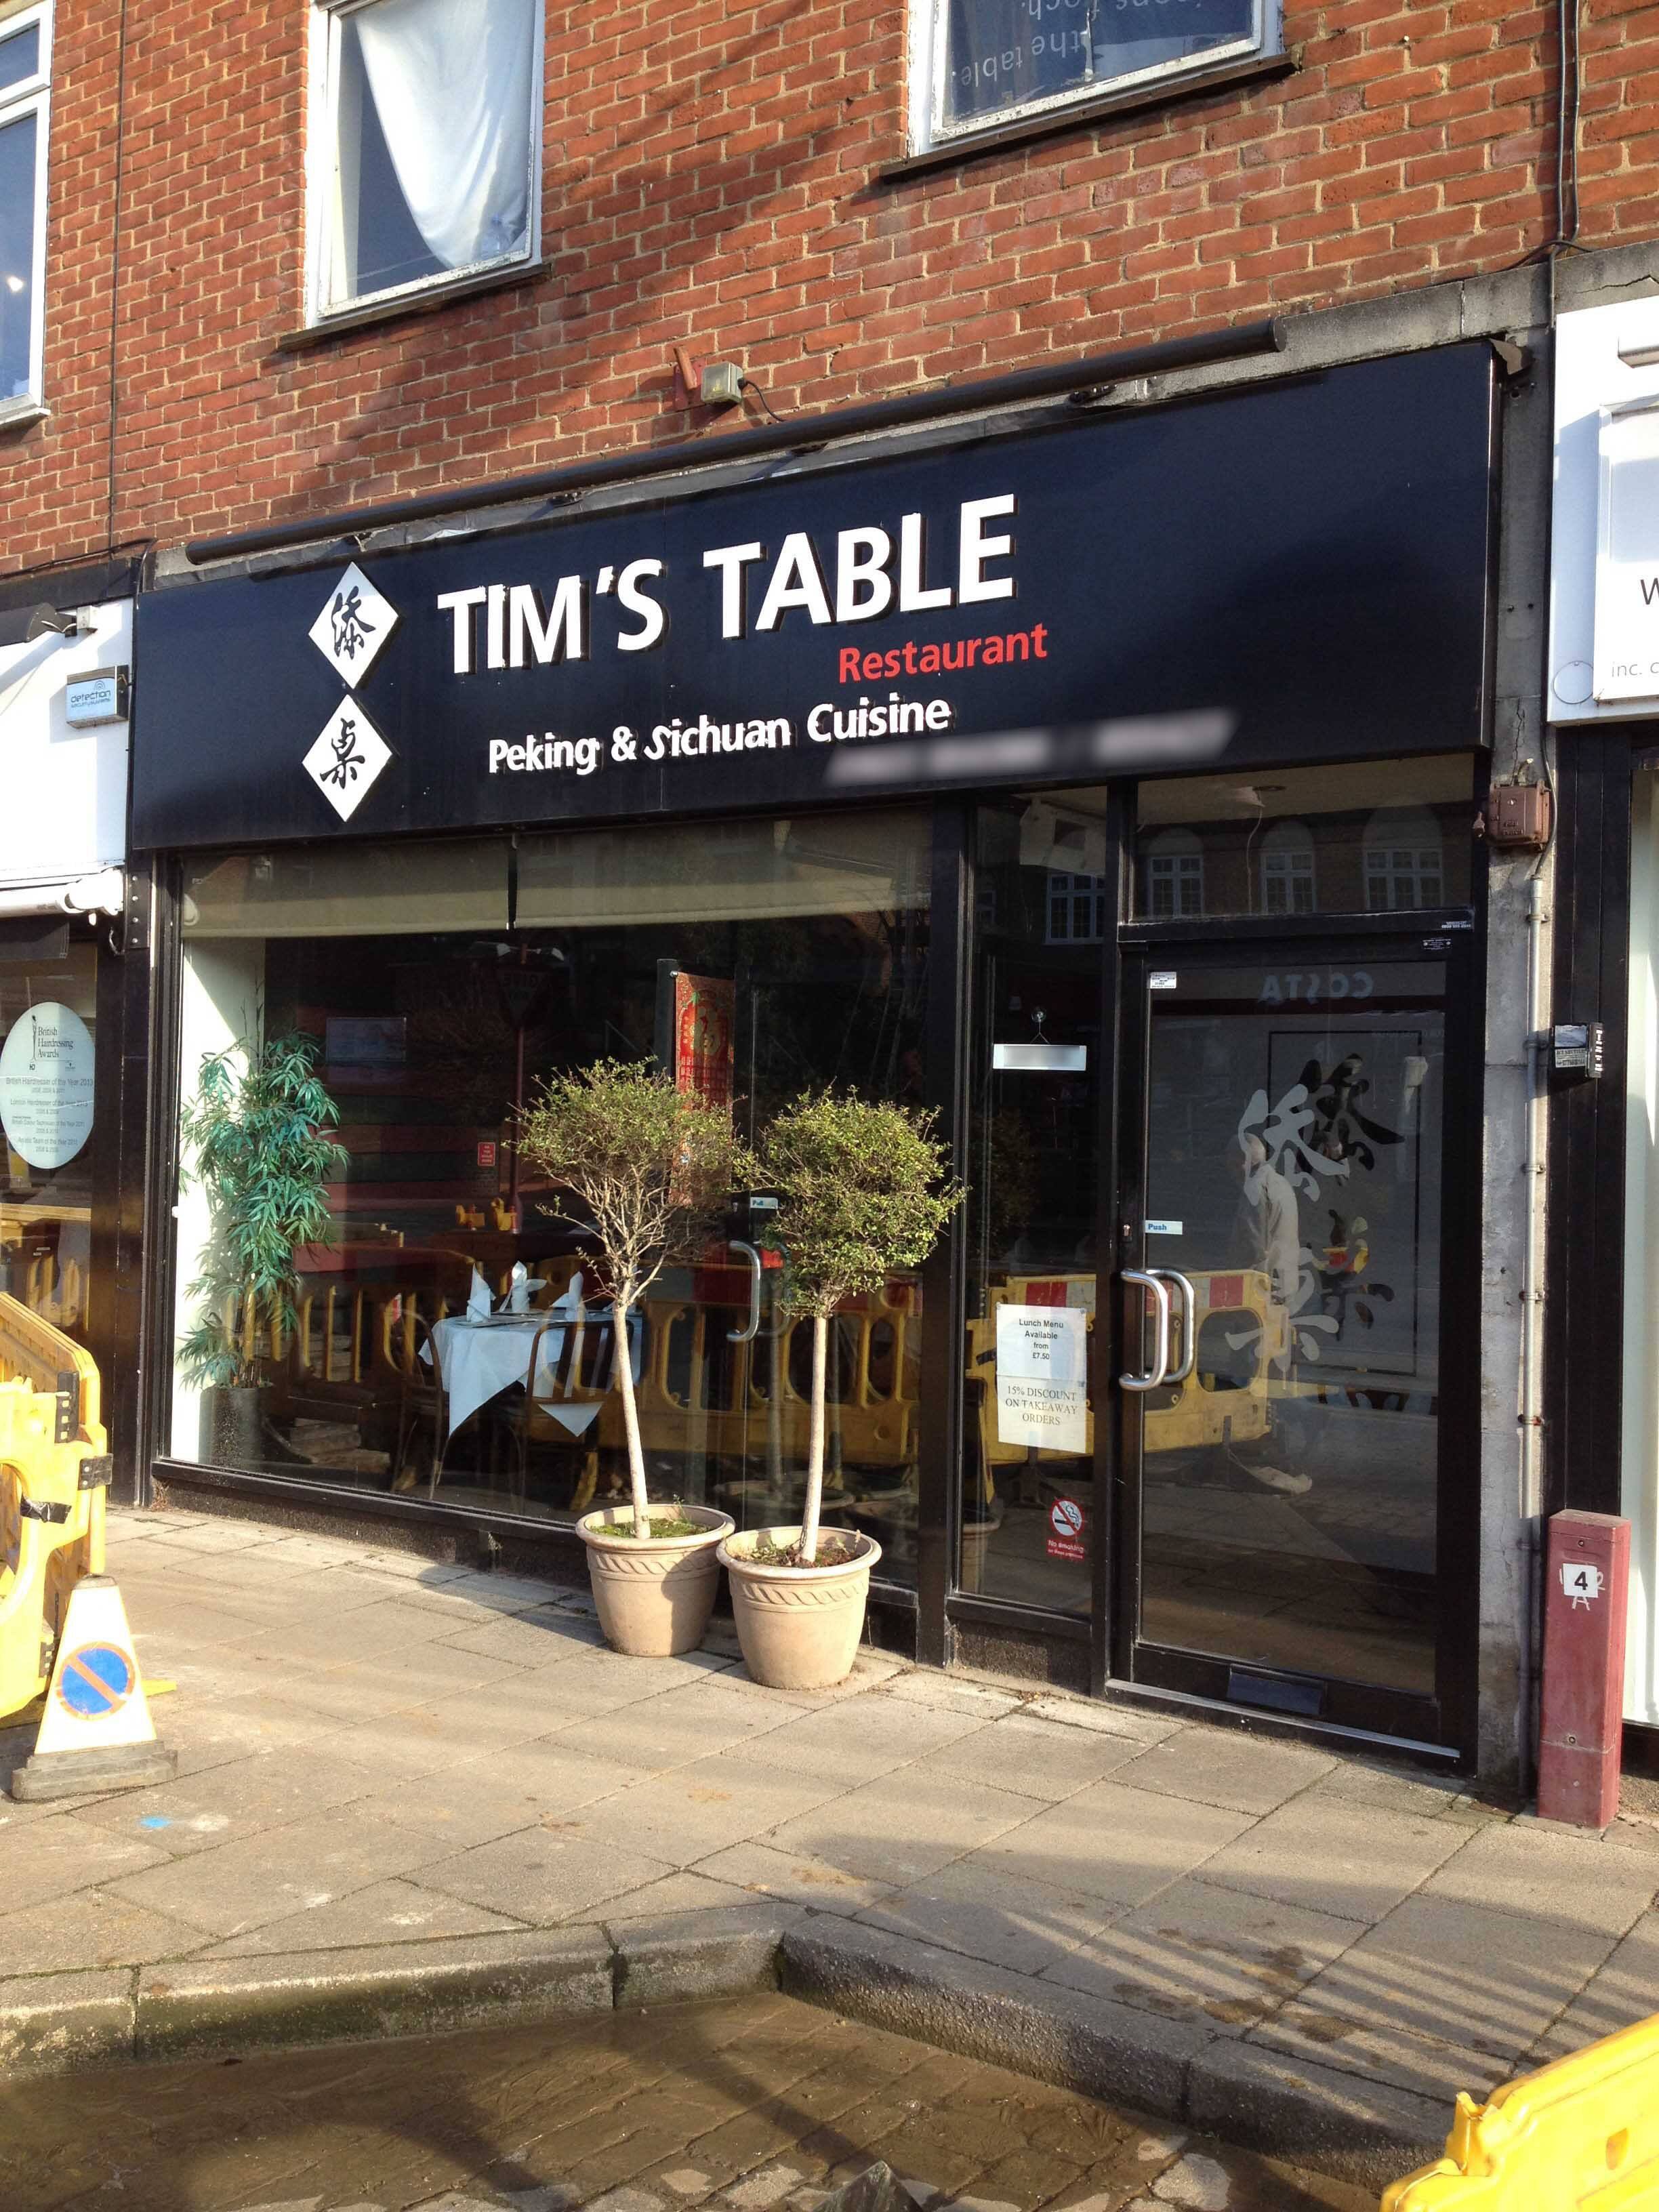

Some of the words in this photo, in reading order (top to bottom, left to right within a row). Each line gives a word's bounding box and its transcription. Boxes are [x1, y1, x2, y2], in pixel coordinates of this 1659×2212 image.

[437, 558, 665, 674] TIM'S
[703, 493, 1016, 639] TABLE
[839, 623, 1048, 683] Restaurant
[1612, 661, 1643, 678] inc.
[488, 731, 601, 775] Peking
[611, 726, 637, 761] &
[644, 714, 791, 760] Sichuan
[806, 691, 951, 742] Cuisine
[1019, 1318, 1042, 1327] Lunch
[1044, 1319, 1064, 1328] Menu
[1025, 1330, 1058, 1340] Available
[1032, 1352, 1050, 1360] £7.50
[1007, 1385, 1025, 1395] 15%
[1027, 1387, 1078, 1401] DISCOUNT
[1005, 1397, 1019, 1407] ON
[1021, 1399, 1078, 1414] TAKEAWAY
[1022, 1413, 1061, 1425] ORDERS
[1048, 1539, 1057, 1547] No
[1574, 1570, 1589, 1591] 4
